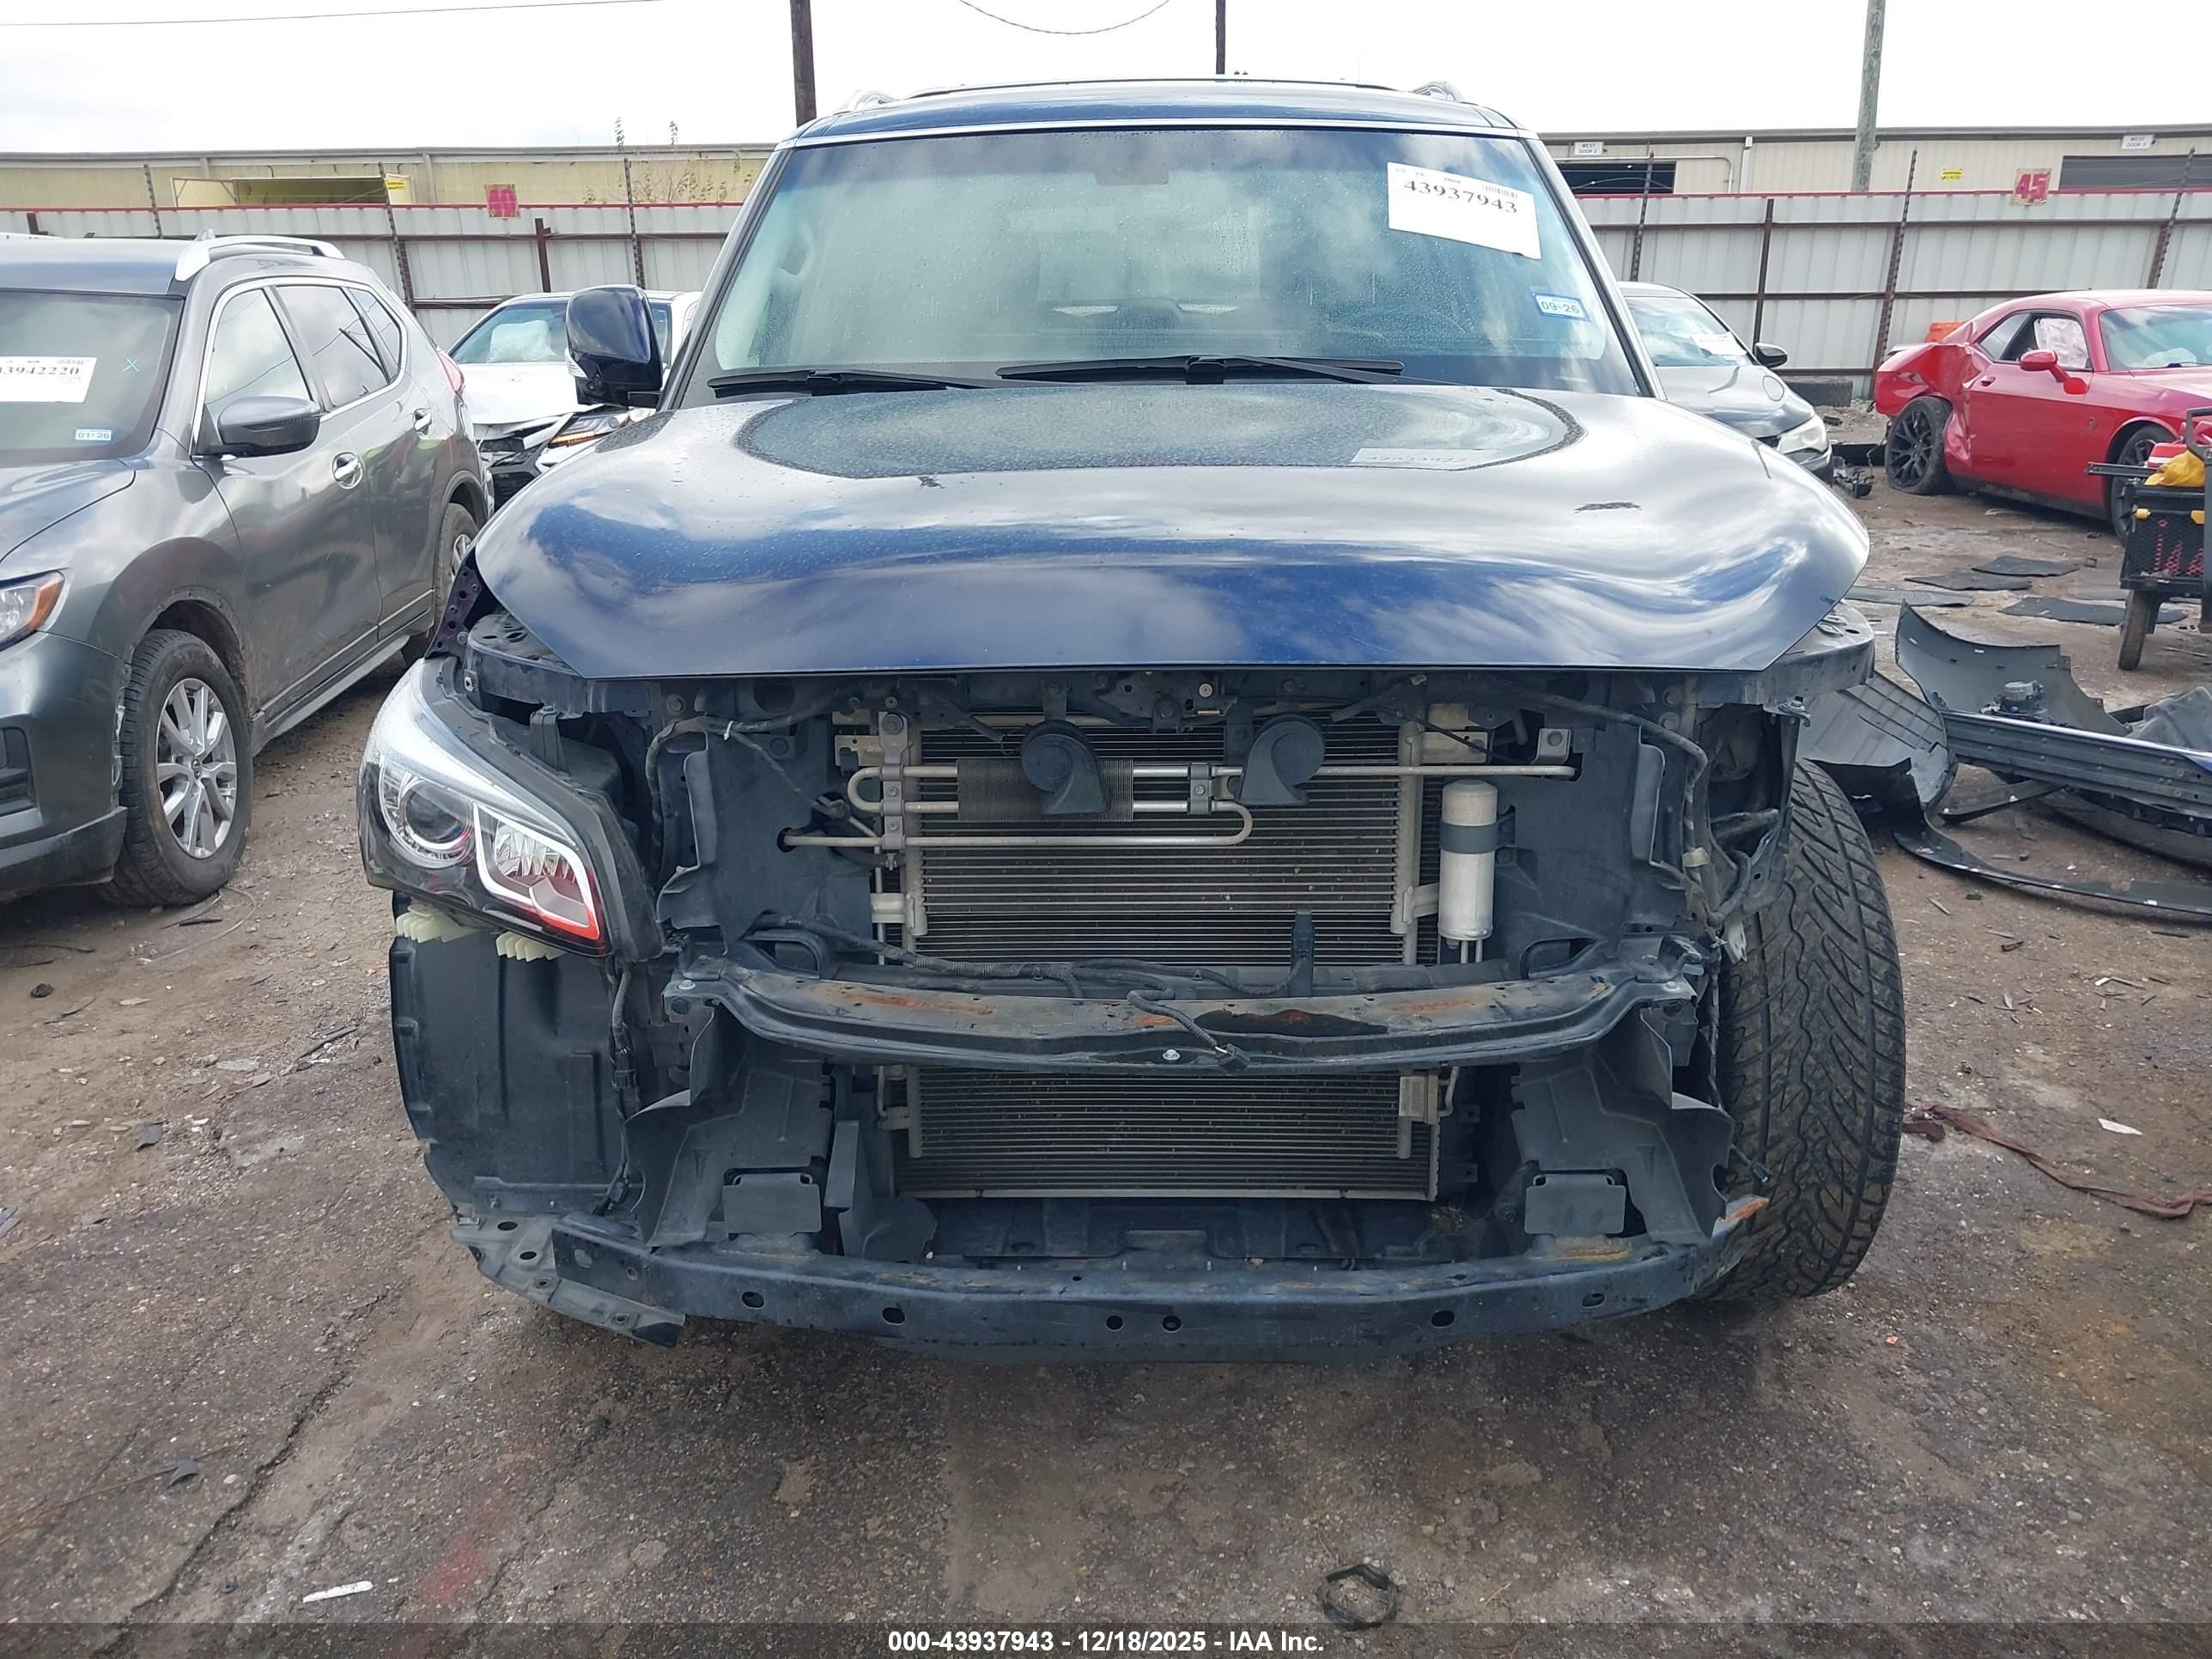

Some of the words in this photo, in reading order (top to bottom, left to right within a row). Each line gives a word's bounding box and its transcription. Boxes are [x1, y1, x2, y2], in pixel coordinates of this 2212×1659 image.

[1404, 179, 1517, 214] 43937943
[2015, 173, 2048, 203] 45
[0, 366, 79, 375] 3942220
